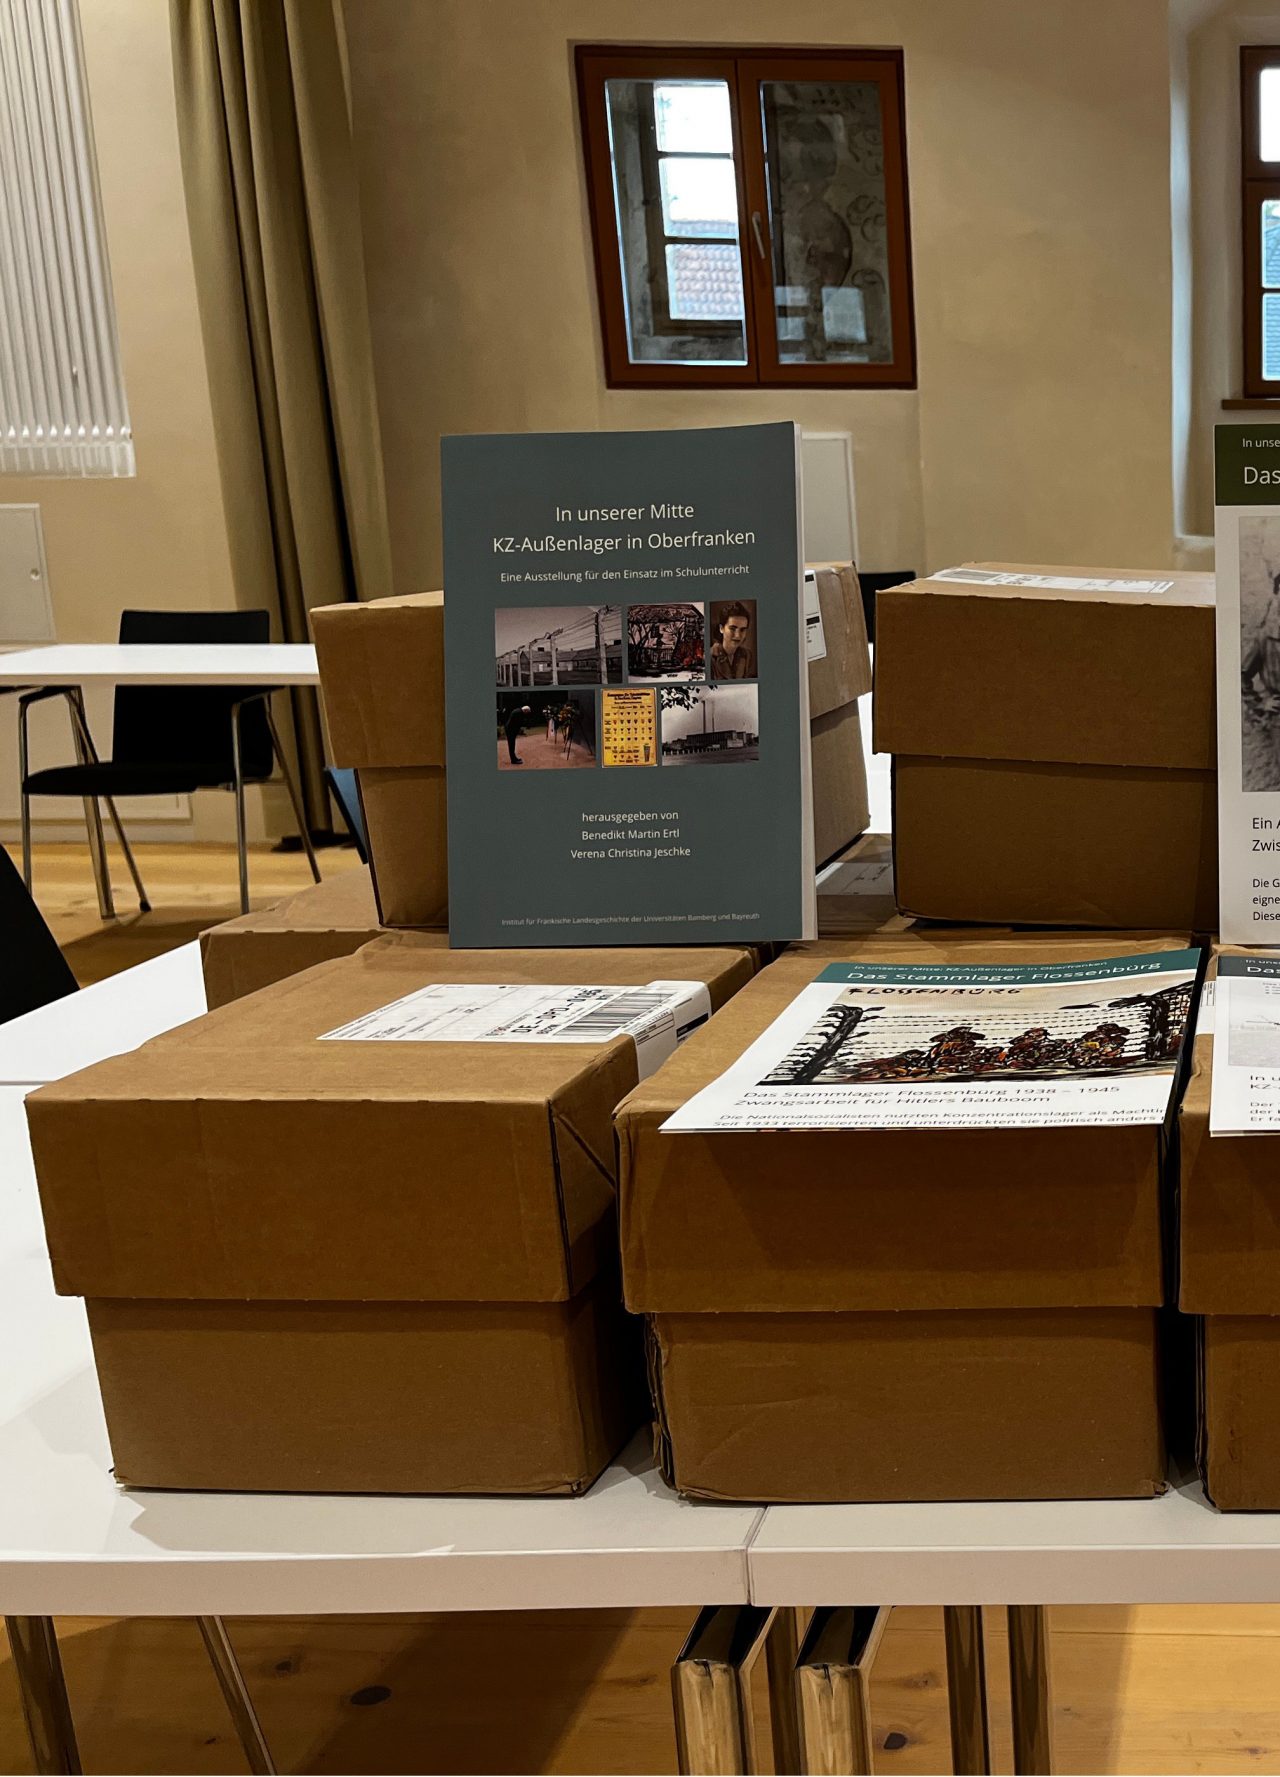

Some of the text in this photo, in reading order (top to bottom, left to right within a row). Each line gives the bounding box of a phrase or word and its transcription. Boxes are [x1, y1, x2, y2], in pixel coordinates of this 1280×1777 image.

[1242, 437, 1253, 448] In
[556, 503, 694, 522] In unserer Mitte
[493, 529, 755, 555] KZ-Außenlager in Oberfranken
[500, 564, 750, 583] Eine Ausstellung für den Einsatz im Schulunterricht
[581, 810, 679, 824] herausgegeben von
[1252, 817, 1273, 830] Ein
[581, 828, 680, 841] Benedikt Martin Ertl
[570, 846, 691, 859] Verena Christina Jeschke
[1252, 878, 1270, 888] Die
[847, 962, 1162, 982] Das Stammlager Flossenbürg
[733, 1099, 858, 1107] Zwangsarbeit
